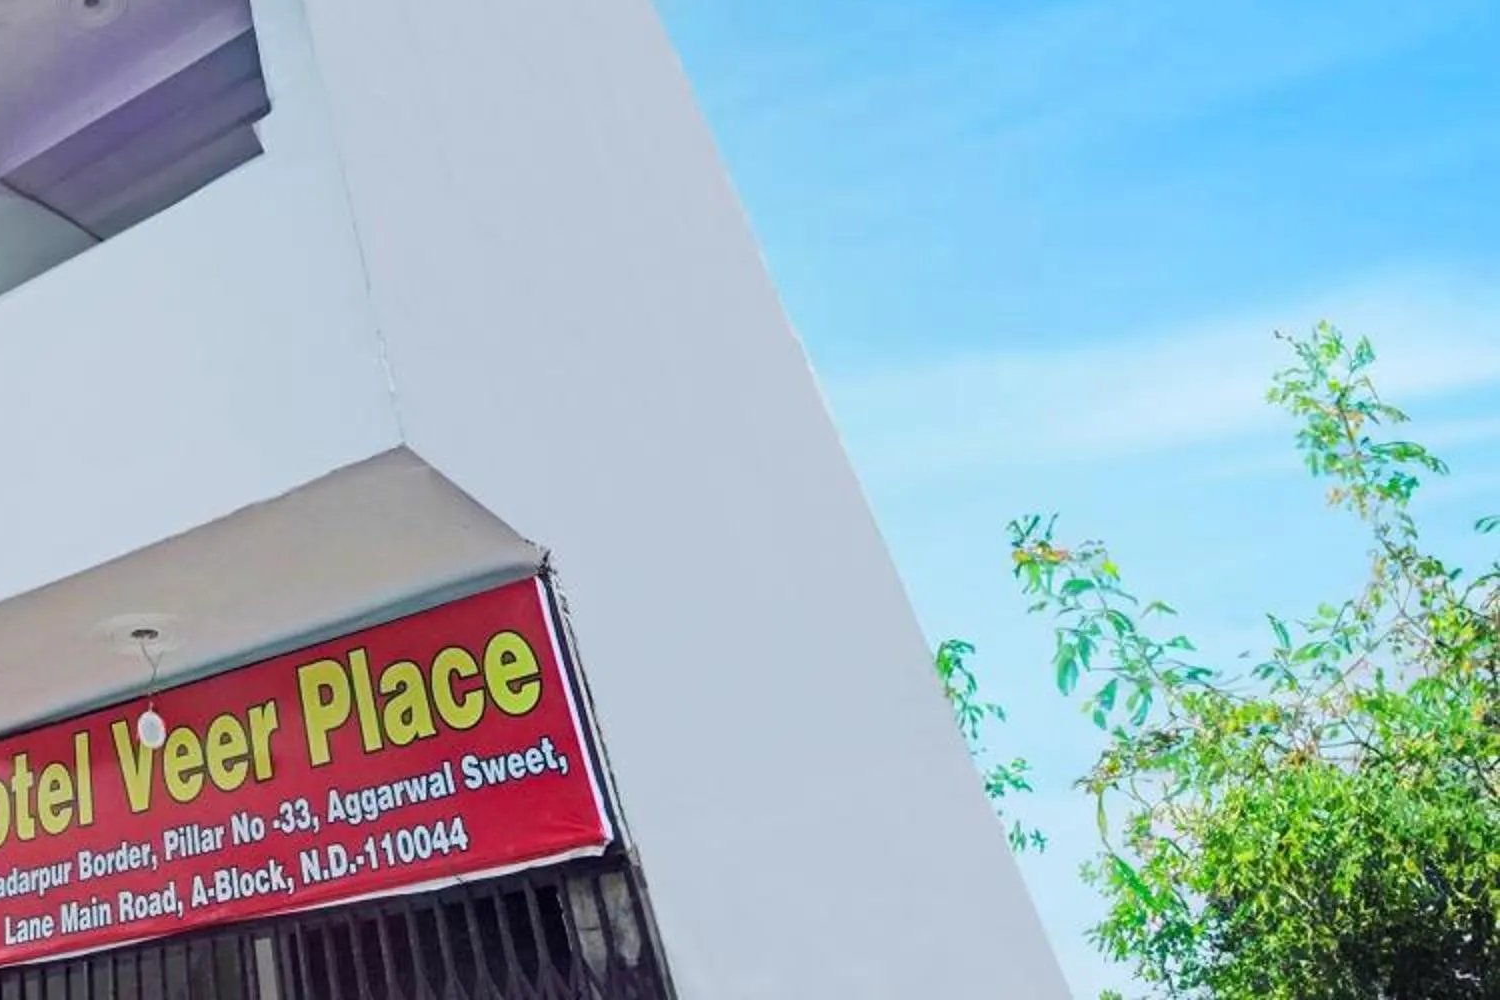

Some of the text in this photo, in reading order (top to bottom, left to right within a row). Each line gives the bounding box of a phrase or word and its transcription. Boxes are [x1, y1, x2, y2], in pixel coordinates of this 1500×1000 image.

[111, 700, 279, 814] Veer
[296, 630, 542, 769] Place
[4, 816, 468, 945] Lane Main Road, A-Block, N.D.-110044
[78, 842, 157, 881] Border,
[163, 824, 225, 861] Pillar
[231, 811, 265, 845] No
[272, 798, 319, 834] -33,
[327, 762, 455, 824] Aggarwal
[461, 736, 568, 791] Sweet,
